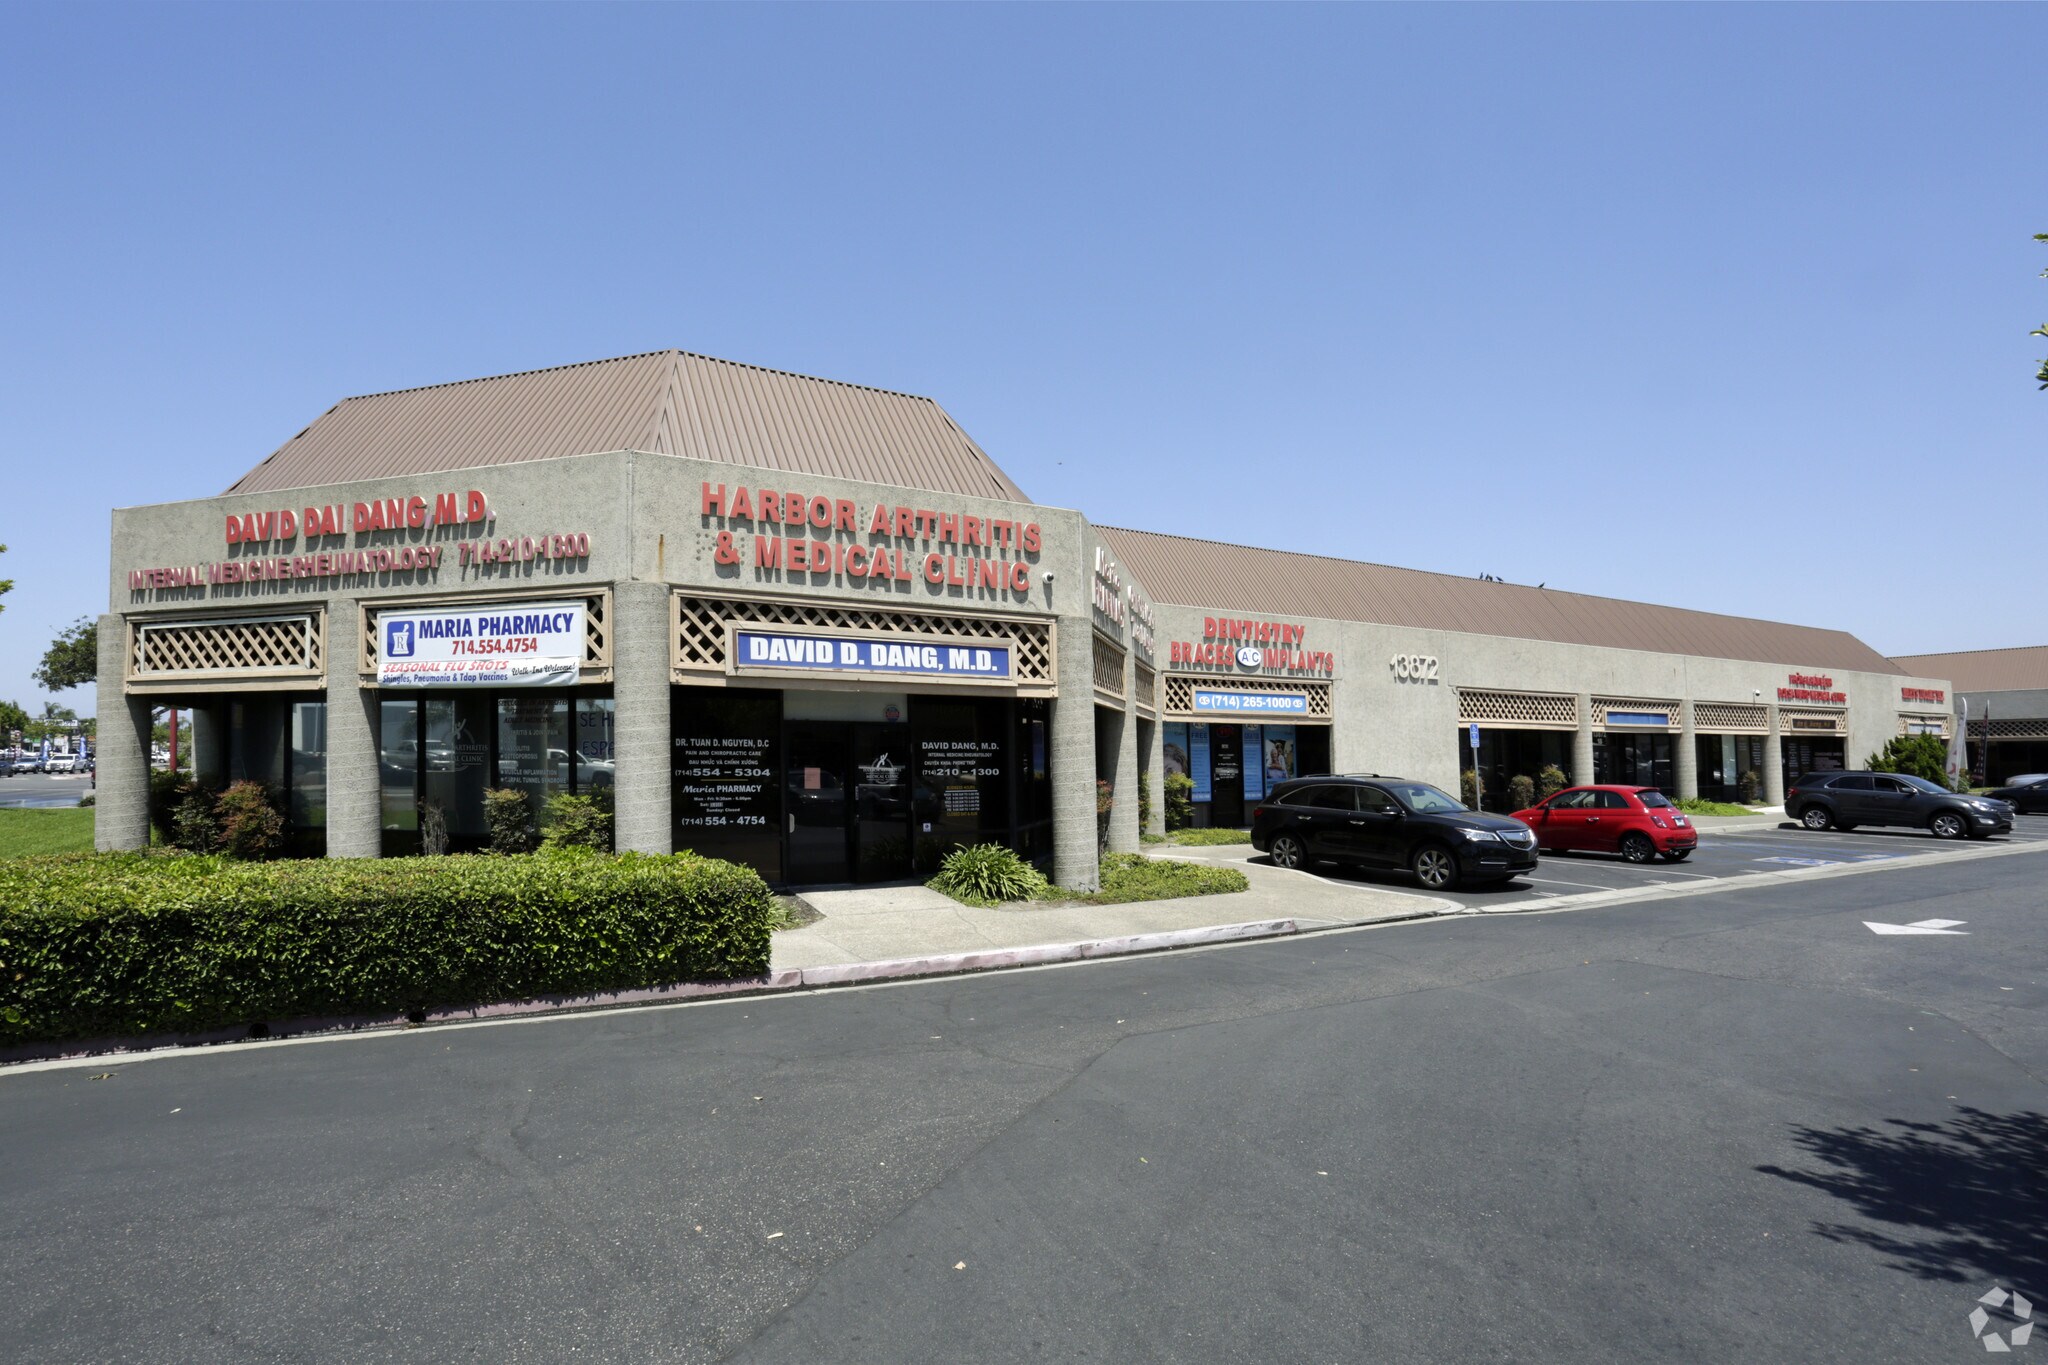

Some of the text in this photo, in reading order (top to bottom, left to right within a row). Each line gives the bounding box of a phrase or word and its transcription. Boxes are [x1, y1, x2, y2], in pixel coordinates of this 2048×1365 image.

[226, 490, 497, 544] DAVID DAI DANG, M.D.
[702, 482, 1041, 552] HARBOR ARTHRITIS
[128, 566, 203, 590] INTERNAL
[458, 533, 590, 566] 714-210-1300
[714, 531, 1030, 592] & MEDICAL CLINIC
[419, 613, 574, 639] MARIA PHARMACY
[1204, 617, 1305, 644] DENTISTRY
[452, 637, 537, 655] 714.554.4754
[749, 637, 998, 671] DAVID D. DANG, M.D.
[1171, 641, 1234, 666] BRACES
[1263, 648, 1333, 671] IMPLANTS
[384, 660, 509, 673] SEASONAL FLU SHOTS
[1390, 654, 1439, 679] 13872
[383, 671, 508, 684] Shingles, Pneumonia & Tdap Vaccines
[1211, 695, 1240, 709] (714)
[1243, 697, 1291, 708] 265-1000
[580, 712, 597, 727] SE
[675, 738, 688, 746] DR.
[690, 738, 711, 747] TUAN
[713, 739, 720, 747] D.
[722, 739, 755, 749] NGUYEN,
[922, 742, 949, 750] DAVID
[952, 742, 979, 751] DANG,
[734, 768, 771, 776] 5304
[971, 768, 999, 776] 1300
[682, 785, 762, 793] Maria PHARMACY
[682, 818, 703, 826] (714)
[705, 817, 726, 825] 554
[737, 816, 766, 825] 4754
